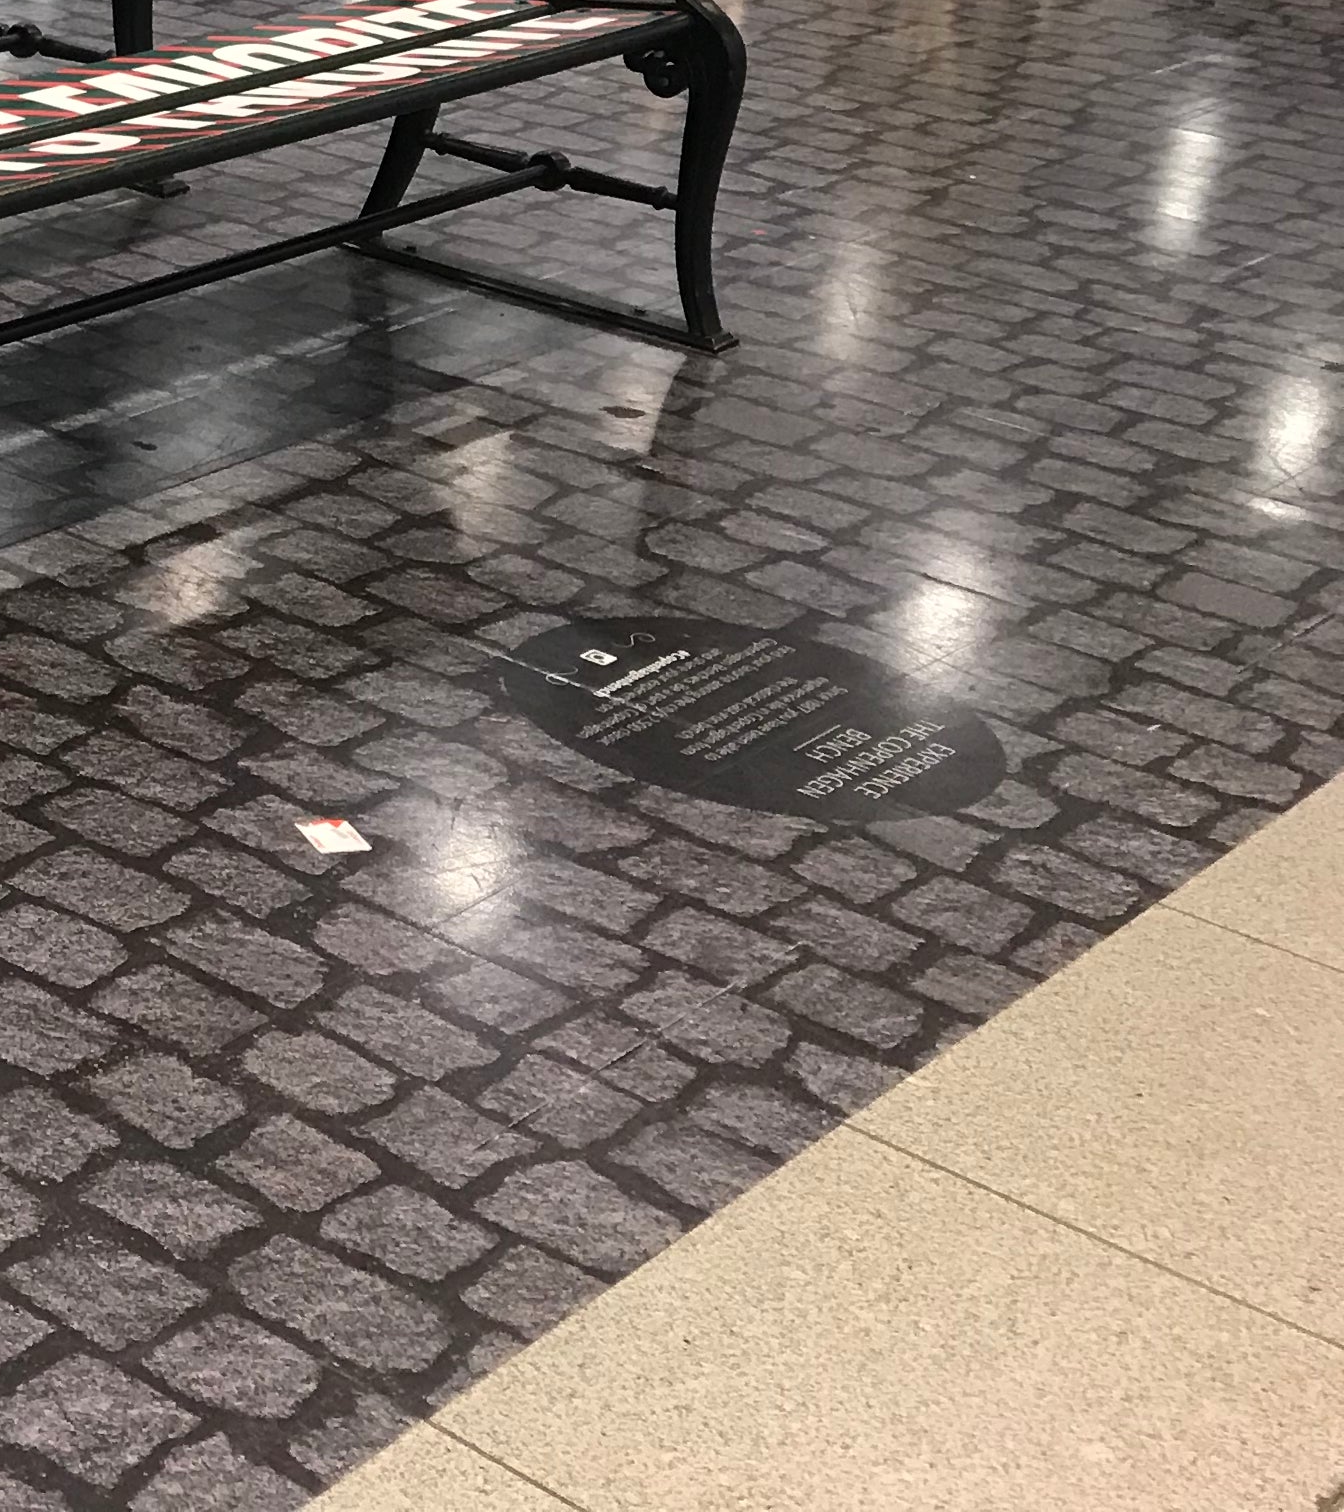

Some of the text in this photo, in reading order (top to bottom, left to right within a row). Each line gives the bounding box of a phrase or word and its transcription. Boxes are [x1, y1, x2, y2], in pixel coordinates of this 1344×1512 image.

[796, 719, 946, 799] THE COPENHAGEN
[804, 728, 872, 764] BENCH
[853, 742, 957, 800] EXPERIENCE
